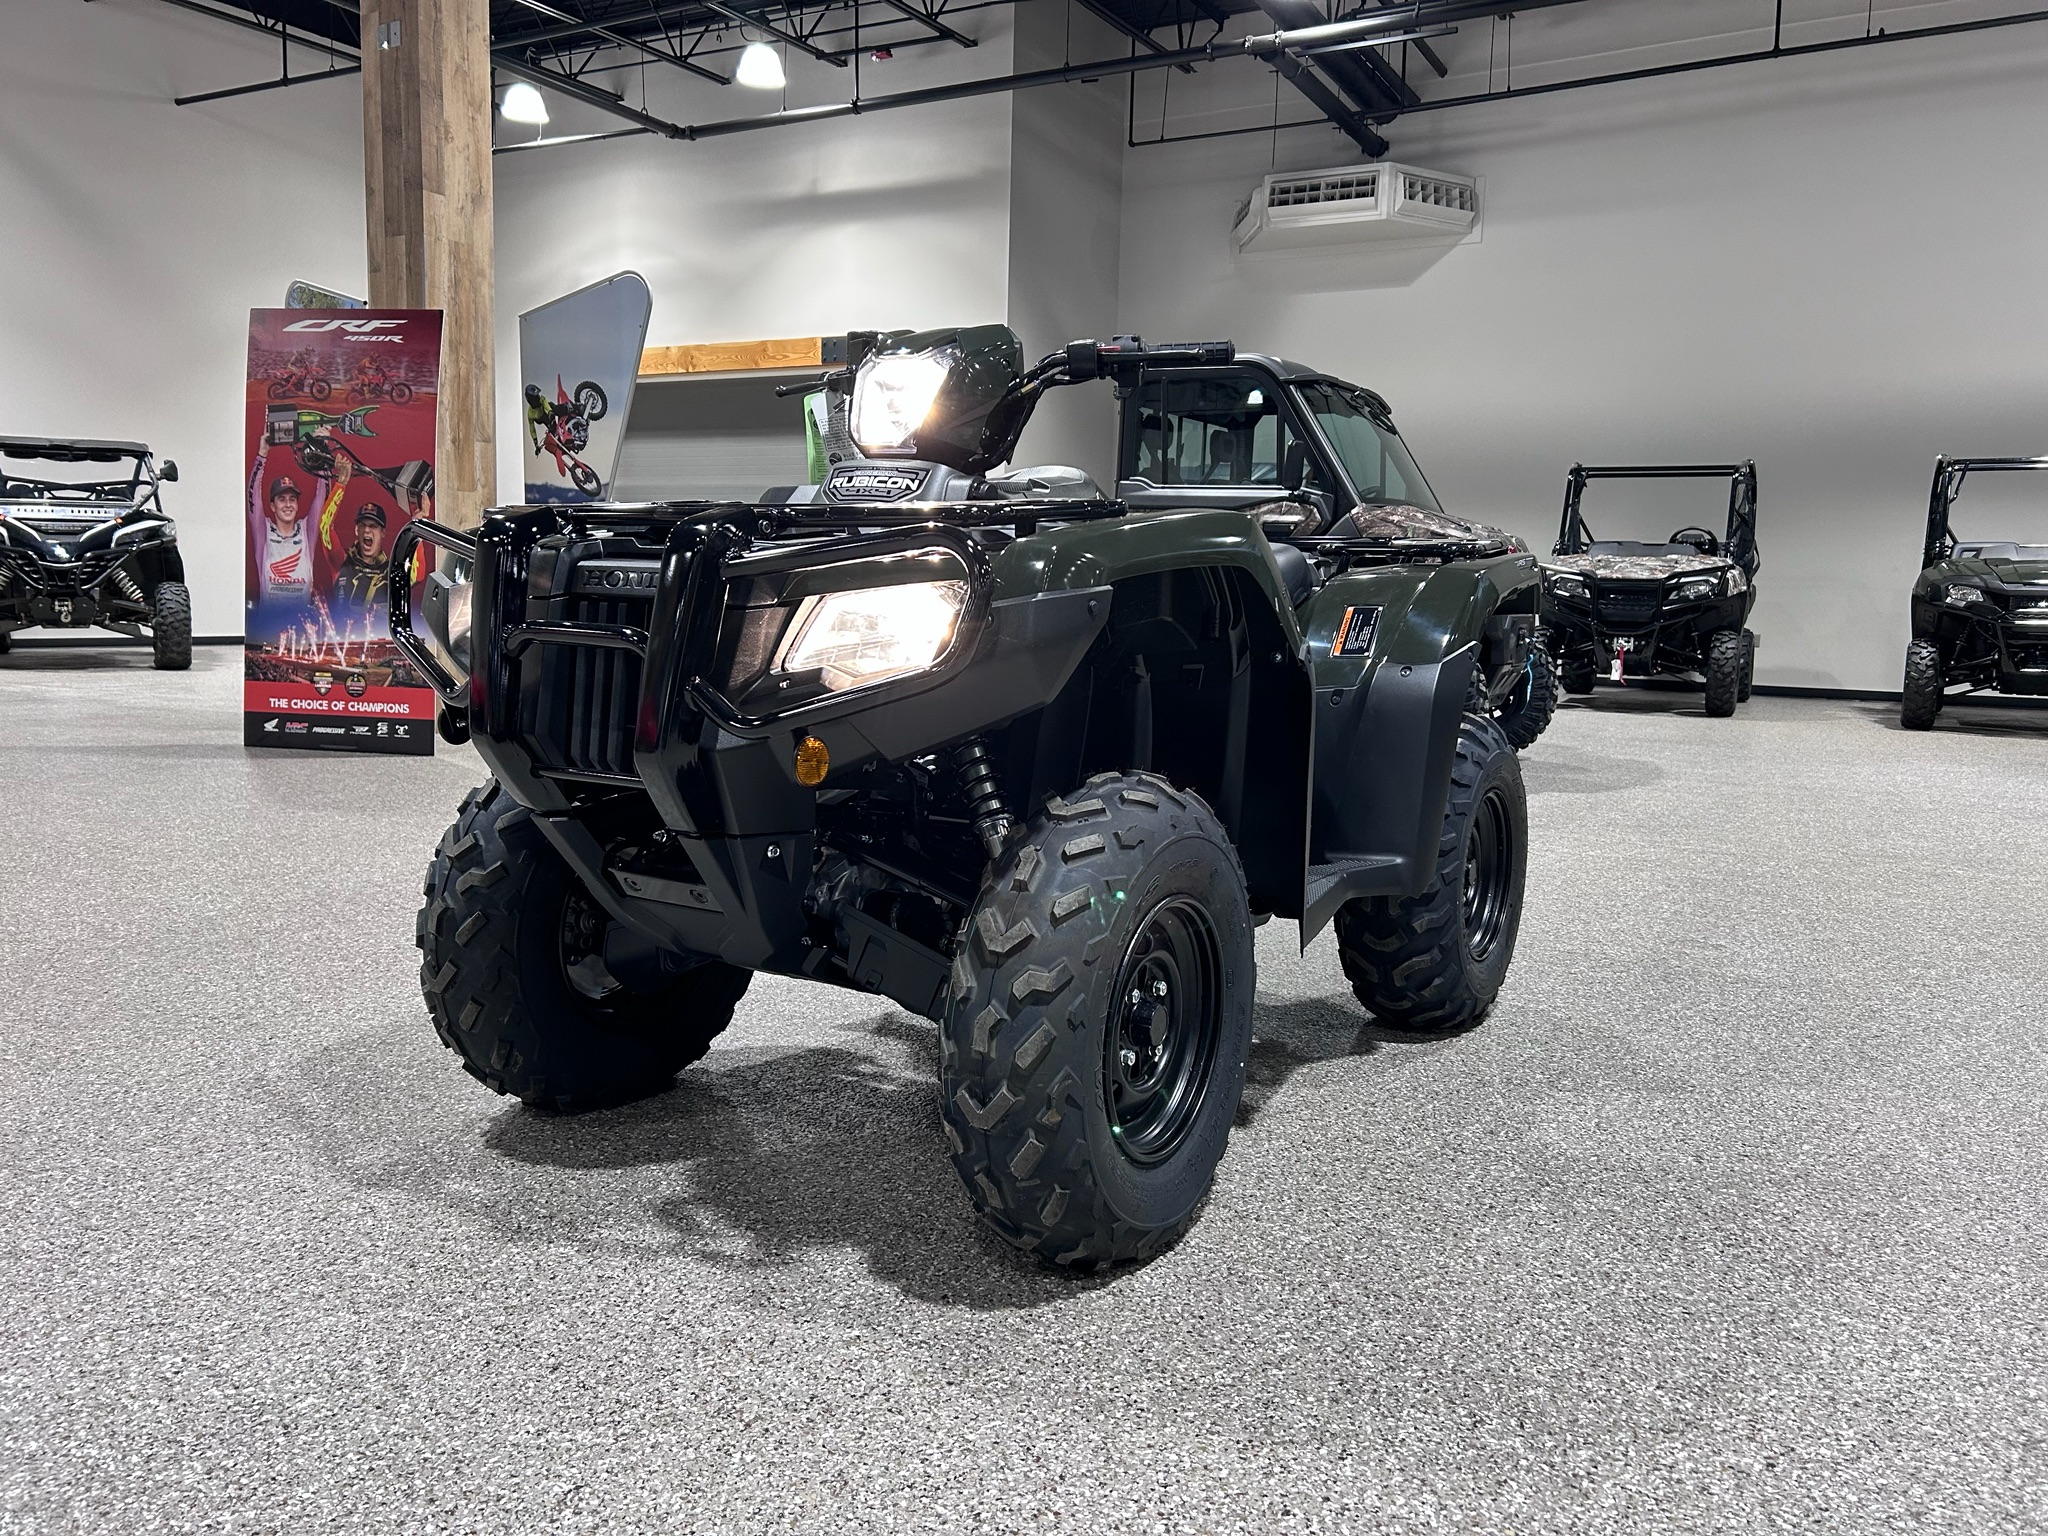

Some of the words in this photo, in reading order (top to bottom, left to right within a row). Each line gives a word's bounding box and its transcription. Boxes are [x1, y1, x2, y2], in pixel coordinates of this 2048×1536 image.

[282, 319, 408, 332] CRF
[343, 335, 404, 343] 450R
[829, 476, 920, 491] RUBICON
[269, 576, 306, 584] HONDA
[582, 569, 660, 589] HON
[269, 698, 289, 709] THE
[291, 699, 328, 710] CHOICE
[331, 701, 346, 711] OF
[348, 701, 410, 714] CHAMPIONS
